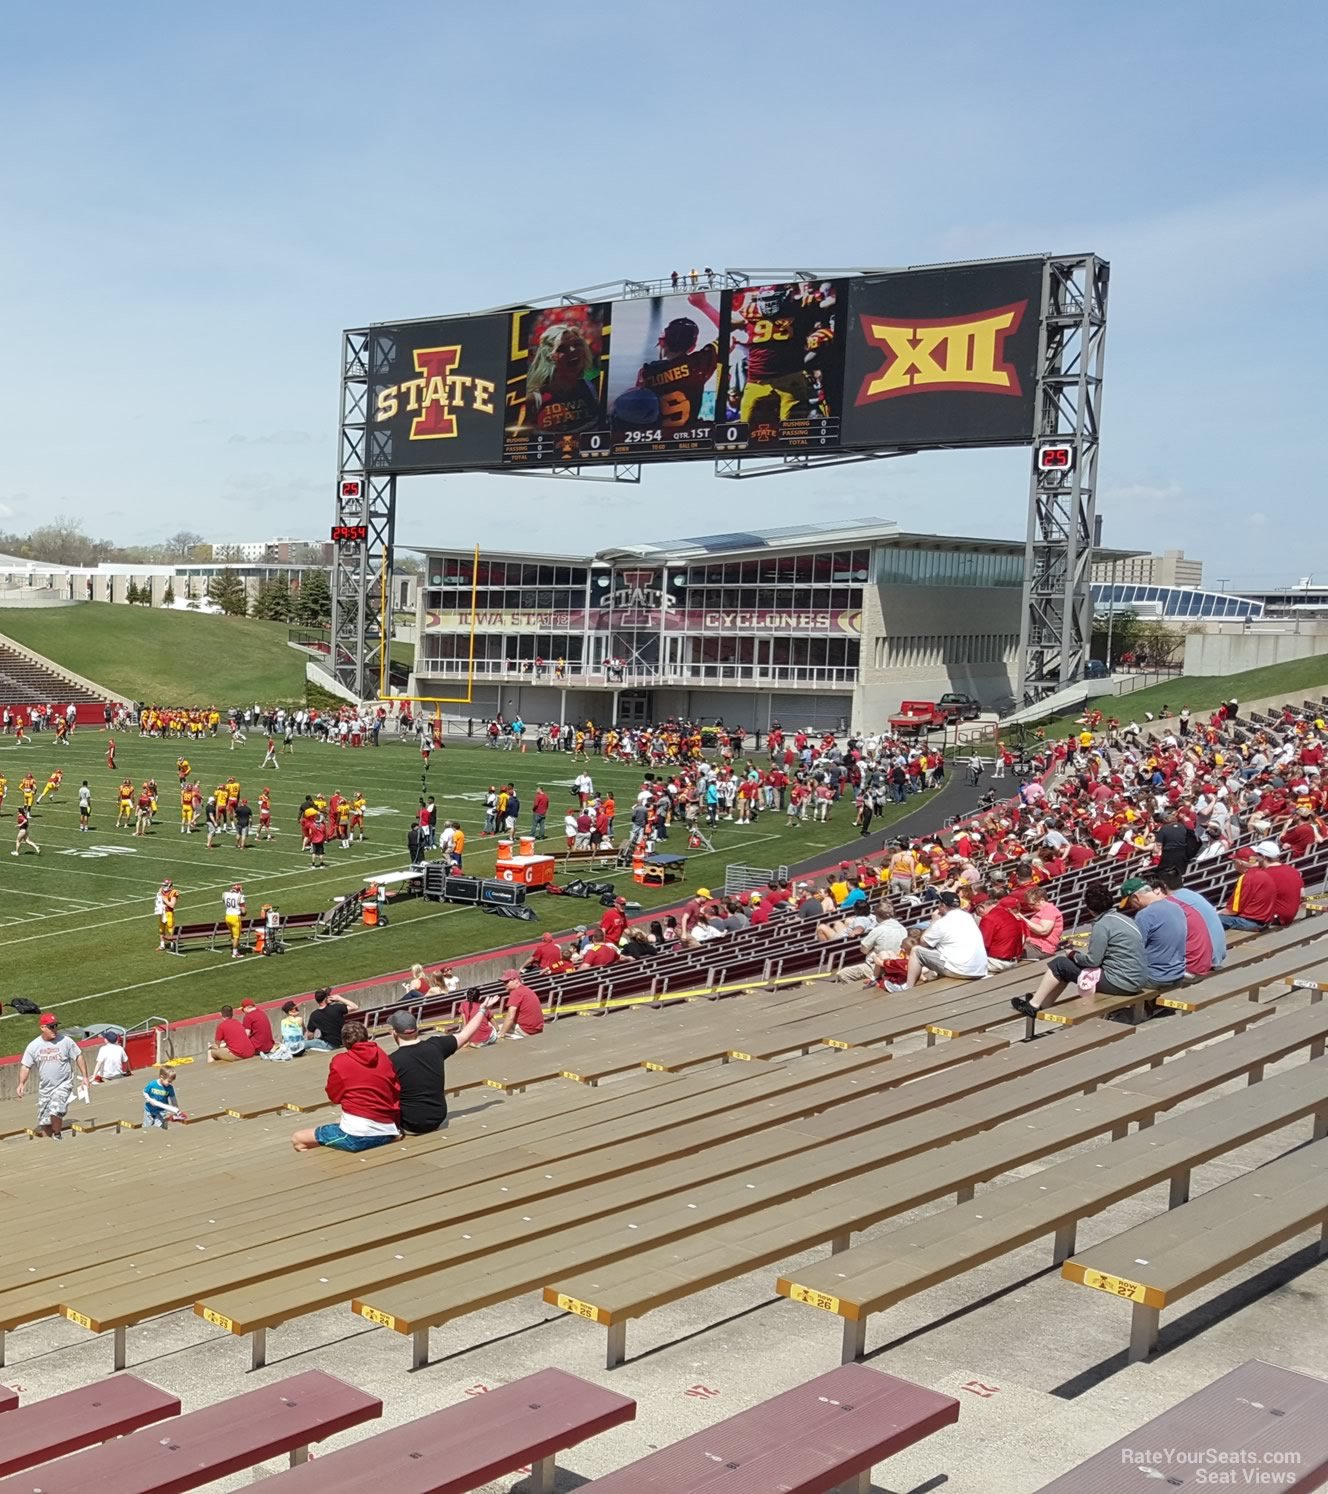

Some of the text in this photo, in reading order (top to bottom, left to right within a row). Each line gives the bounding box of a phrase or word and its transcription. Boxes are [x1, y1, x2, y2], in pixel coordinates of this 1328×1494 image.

[867, 311, 1015, 396] XII
[375, 376, 494, 422] STATE
[624, 430, 662, 443] 29:54
[691, 428, 710, 439] 1ST
[726, 427, 737, 441] 0
[590, 435, 600, 449] 0
[1044, 450, 1066, 466] 25
[343, 483, 358, 496] 25
[459, 612, 570, 626] IOWA STATE
[706, 613, 830, 628] CYCLONES
[55, 846, 137, 858] 50
[525, 866, 533, 882] G
[226, 898, 236, 909] 60
[1117, 1285, 1135, 1298] 27
[1118, 1280, 1137, 1290] ROW
[818, 1293, 833, 1302] ROW
[580, 1303, 592, 1311] ROW
[817, 1299, 832, 1310] 26
[580, 1308, 592, 1318] 25
[219, 1320, 228, 1329] 23
[380, 1317, 390, 1326] 24
